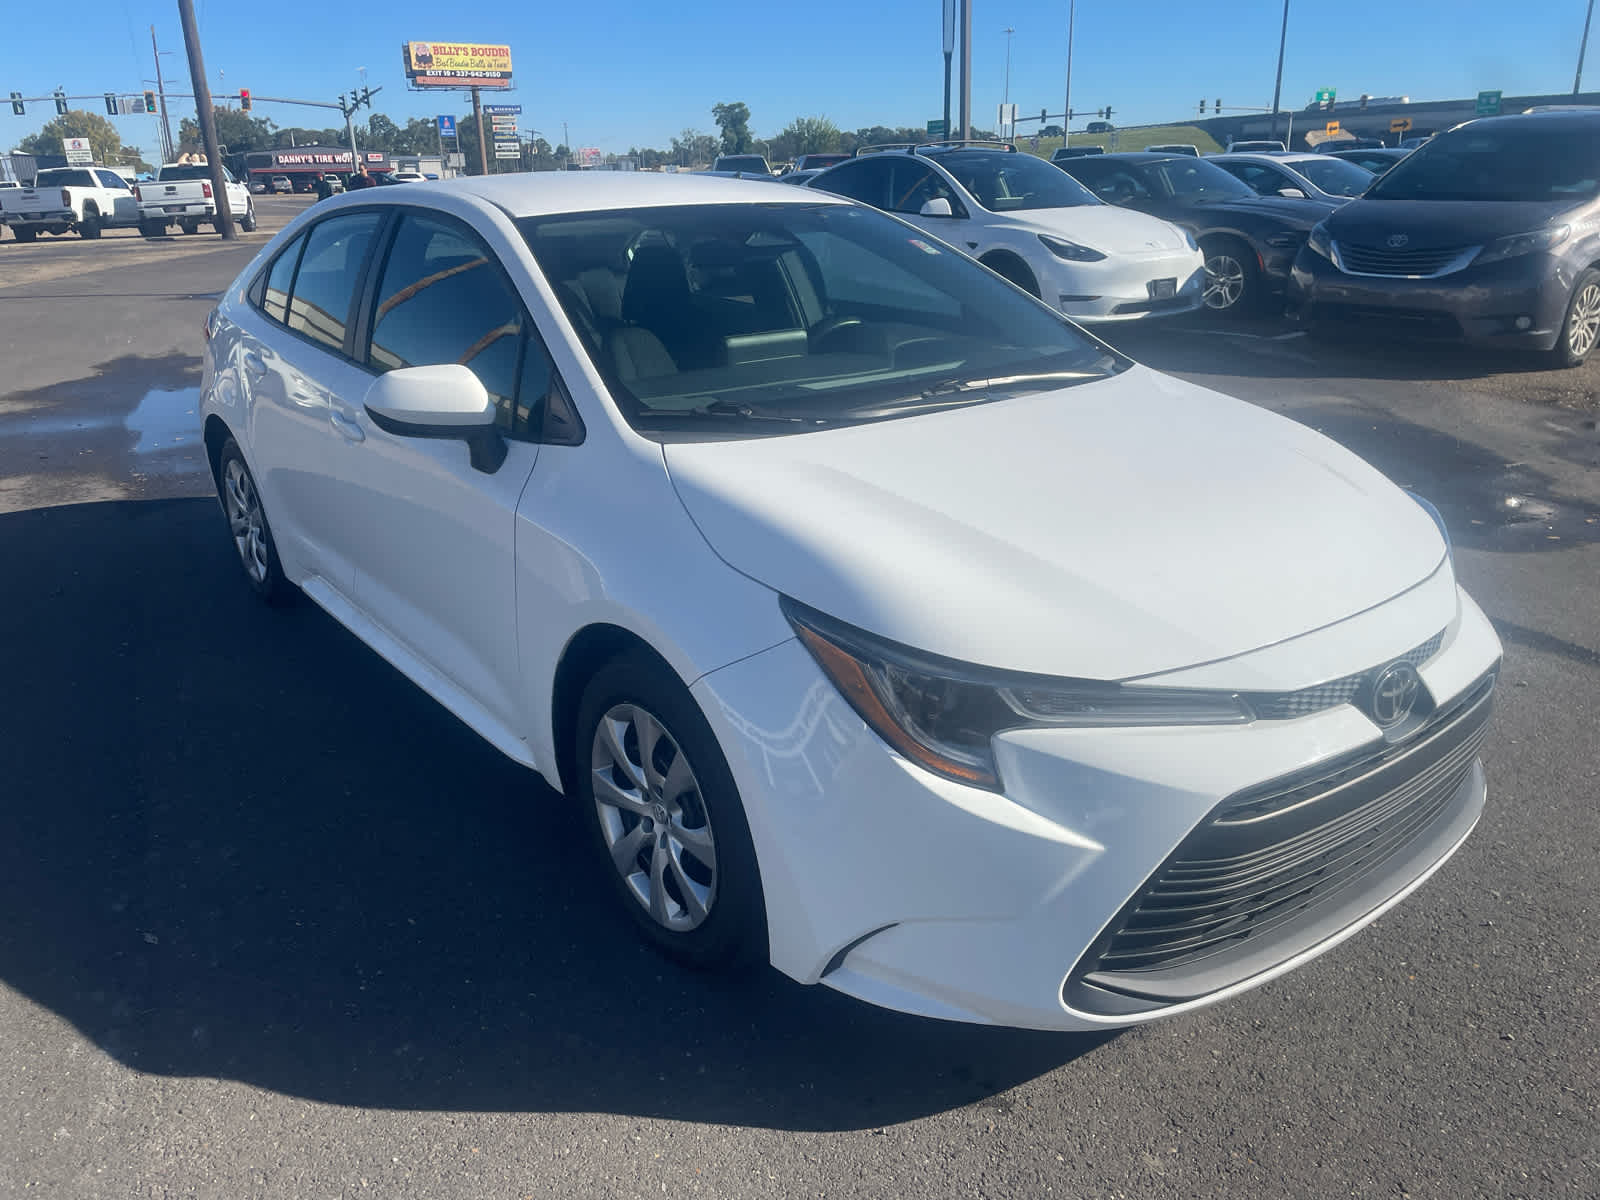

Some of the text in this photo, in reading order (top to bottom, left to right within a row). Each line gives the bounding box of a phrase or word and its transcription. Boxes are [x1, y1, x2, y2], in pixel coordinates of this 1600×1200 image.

[432, 46, 508, 56] BILLY'S BOUDIN
[278, 154, 313, 163] DANNY'S
[315, 154, 333, 163] TIRE
